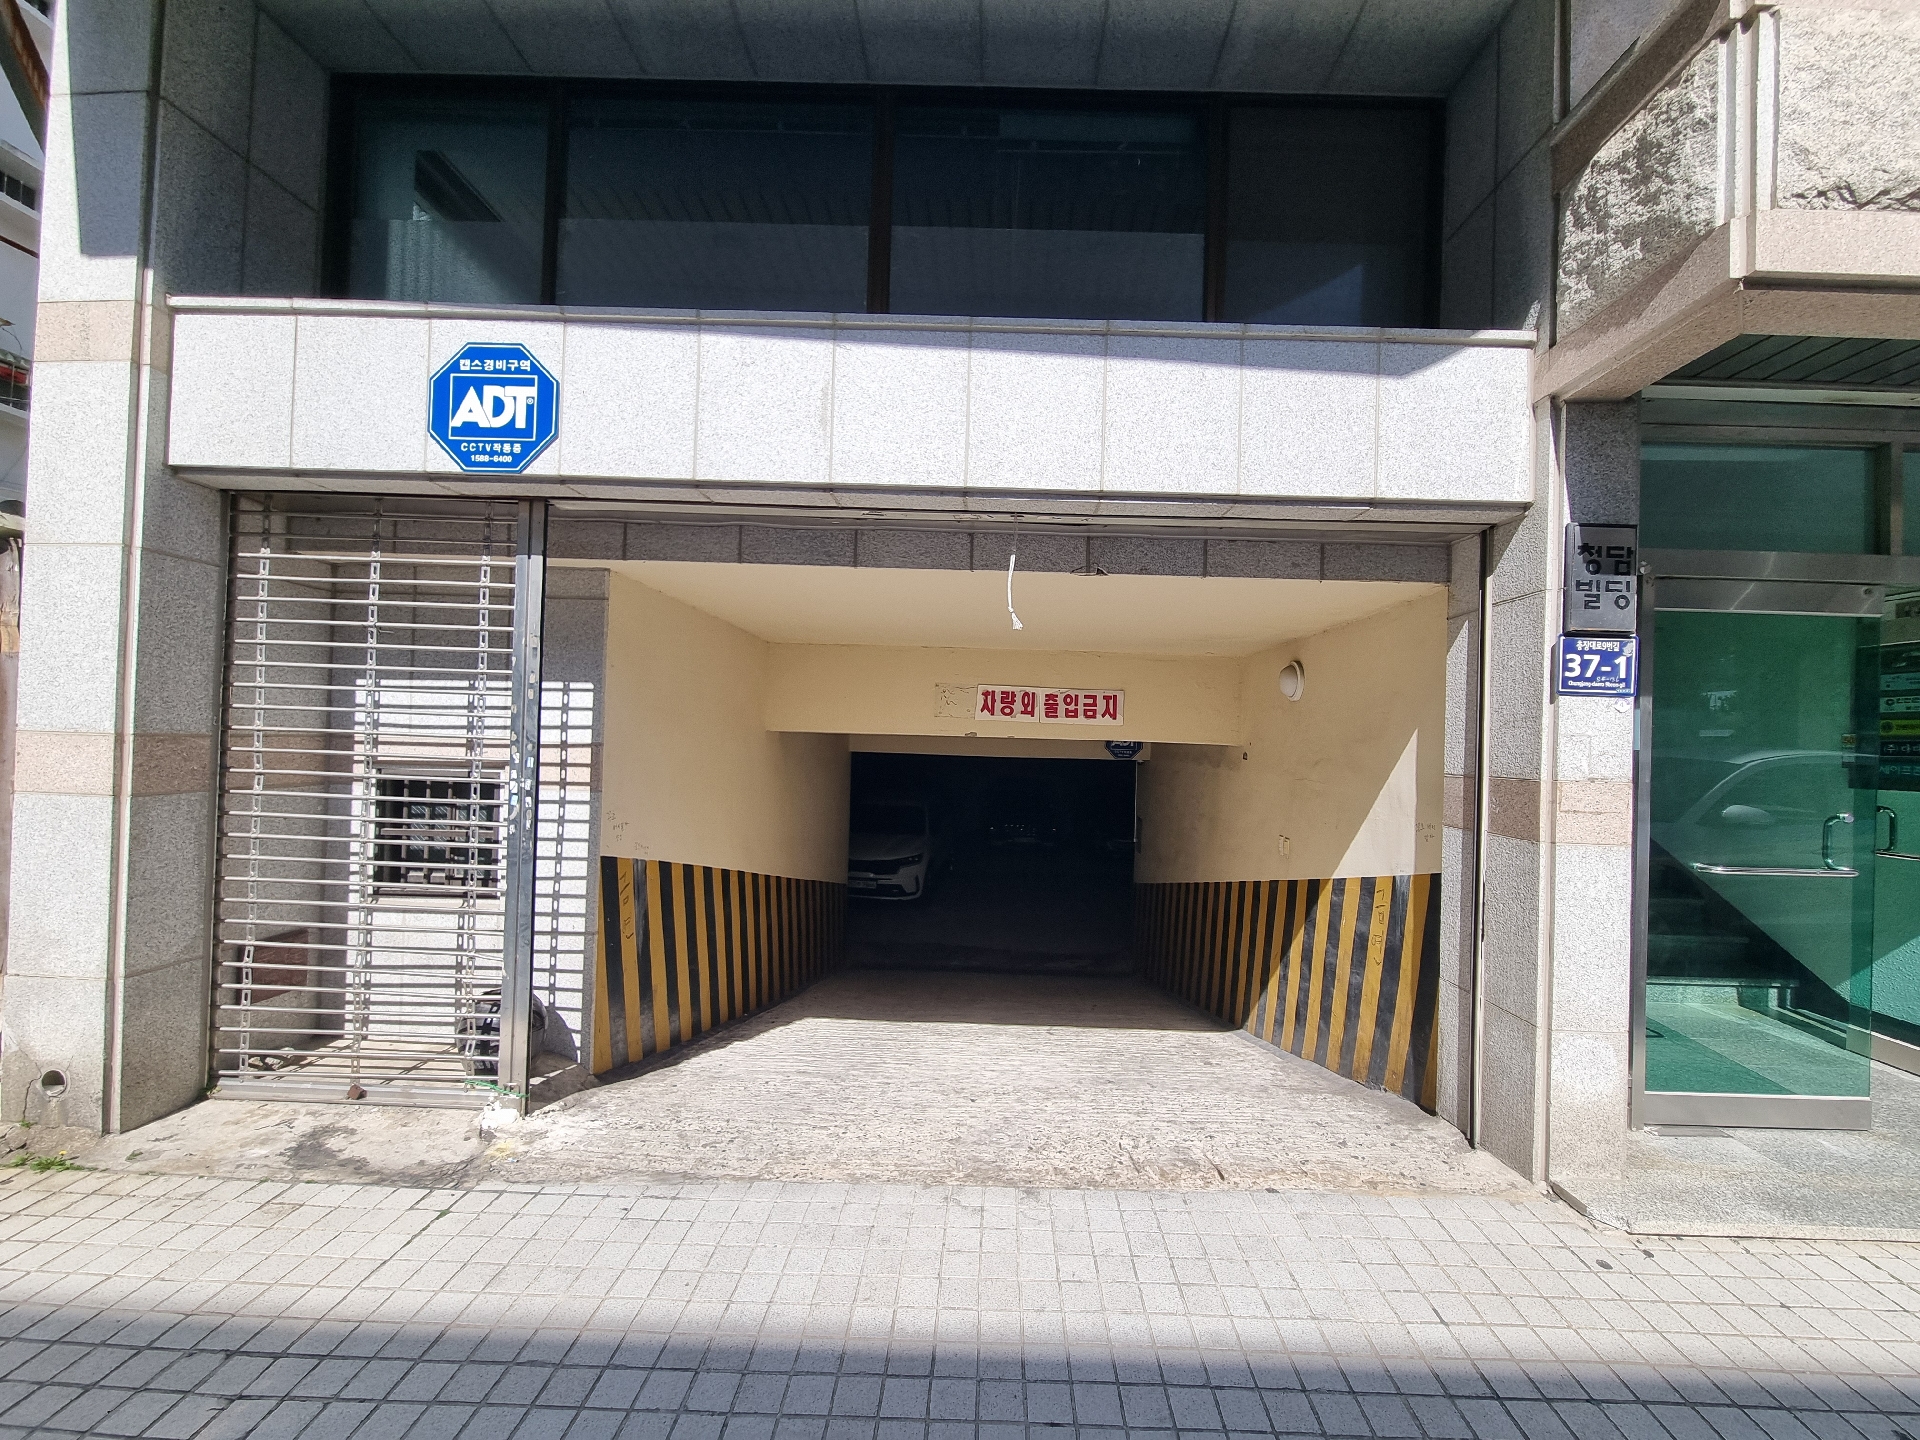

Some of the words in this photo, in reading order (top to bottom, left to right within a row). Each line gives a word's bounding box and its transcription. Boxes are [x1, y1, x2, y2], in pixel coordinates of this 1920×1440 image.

[459, 358, 531, 372] 캡스경비구역
[451, 385, 537, 429] ADT
[460, 442, 522, 454] CCTV작동중
[470, 454, 513, 463] 1588-6400
[1577, 542, 1634, 576] 청담
[1575, 579, 1631, 610] 빌딩
[1576, 640, 1620, 652] 충장대로9번길
[1564, 653, 1627, 679] 37-1
[1043, 692, 1118, 721] 출입금지
